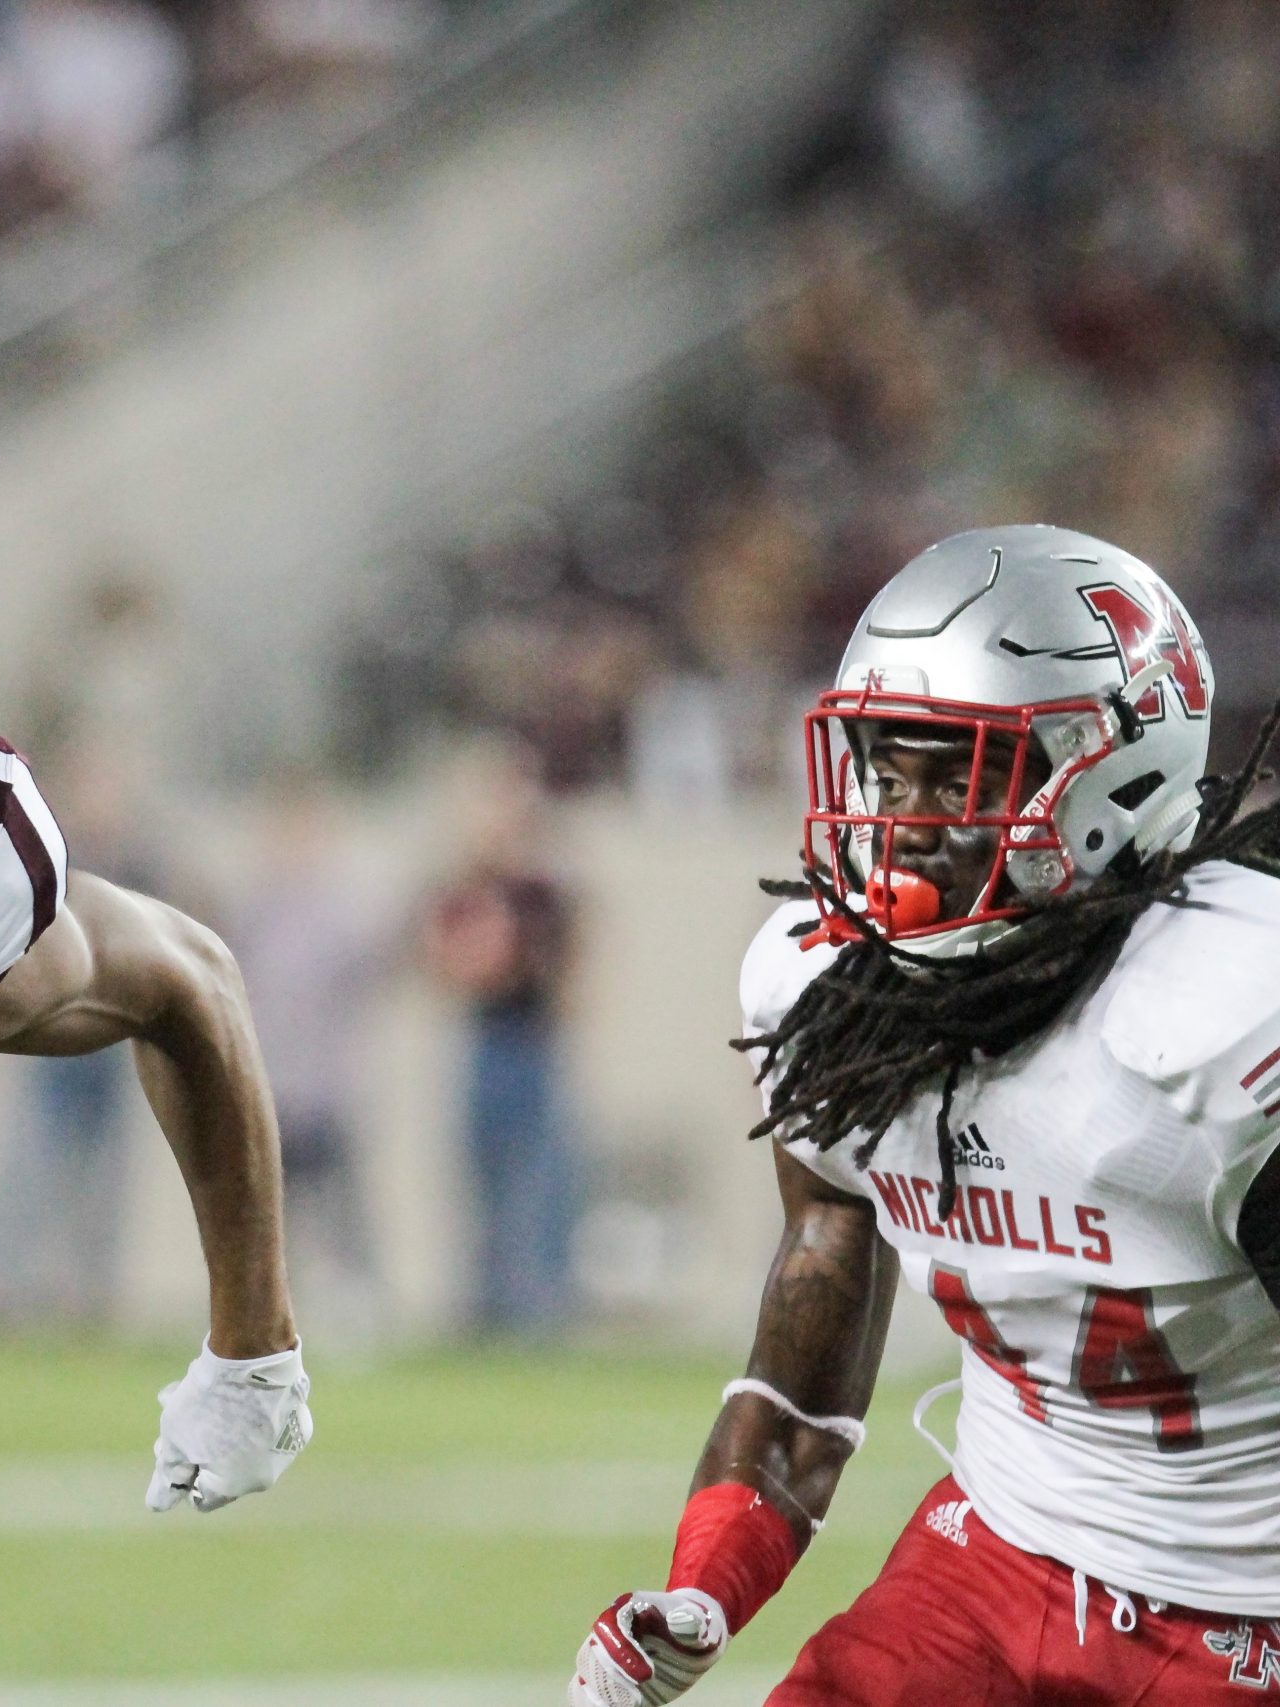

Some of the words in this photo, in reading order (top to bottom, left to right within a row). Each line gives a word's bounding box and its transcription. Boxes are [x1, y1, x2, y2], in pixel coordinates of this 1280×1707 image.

[1079, 581, 1209, 723] N
[953, 1147, 1006, 1171] didas
[868, 1170, 1113, 1265] NICHOLLS
